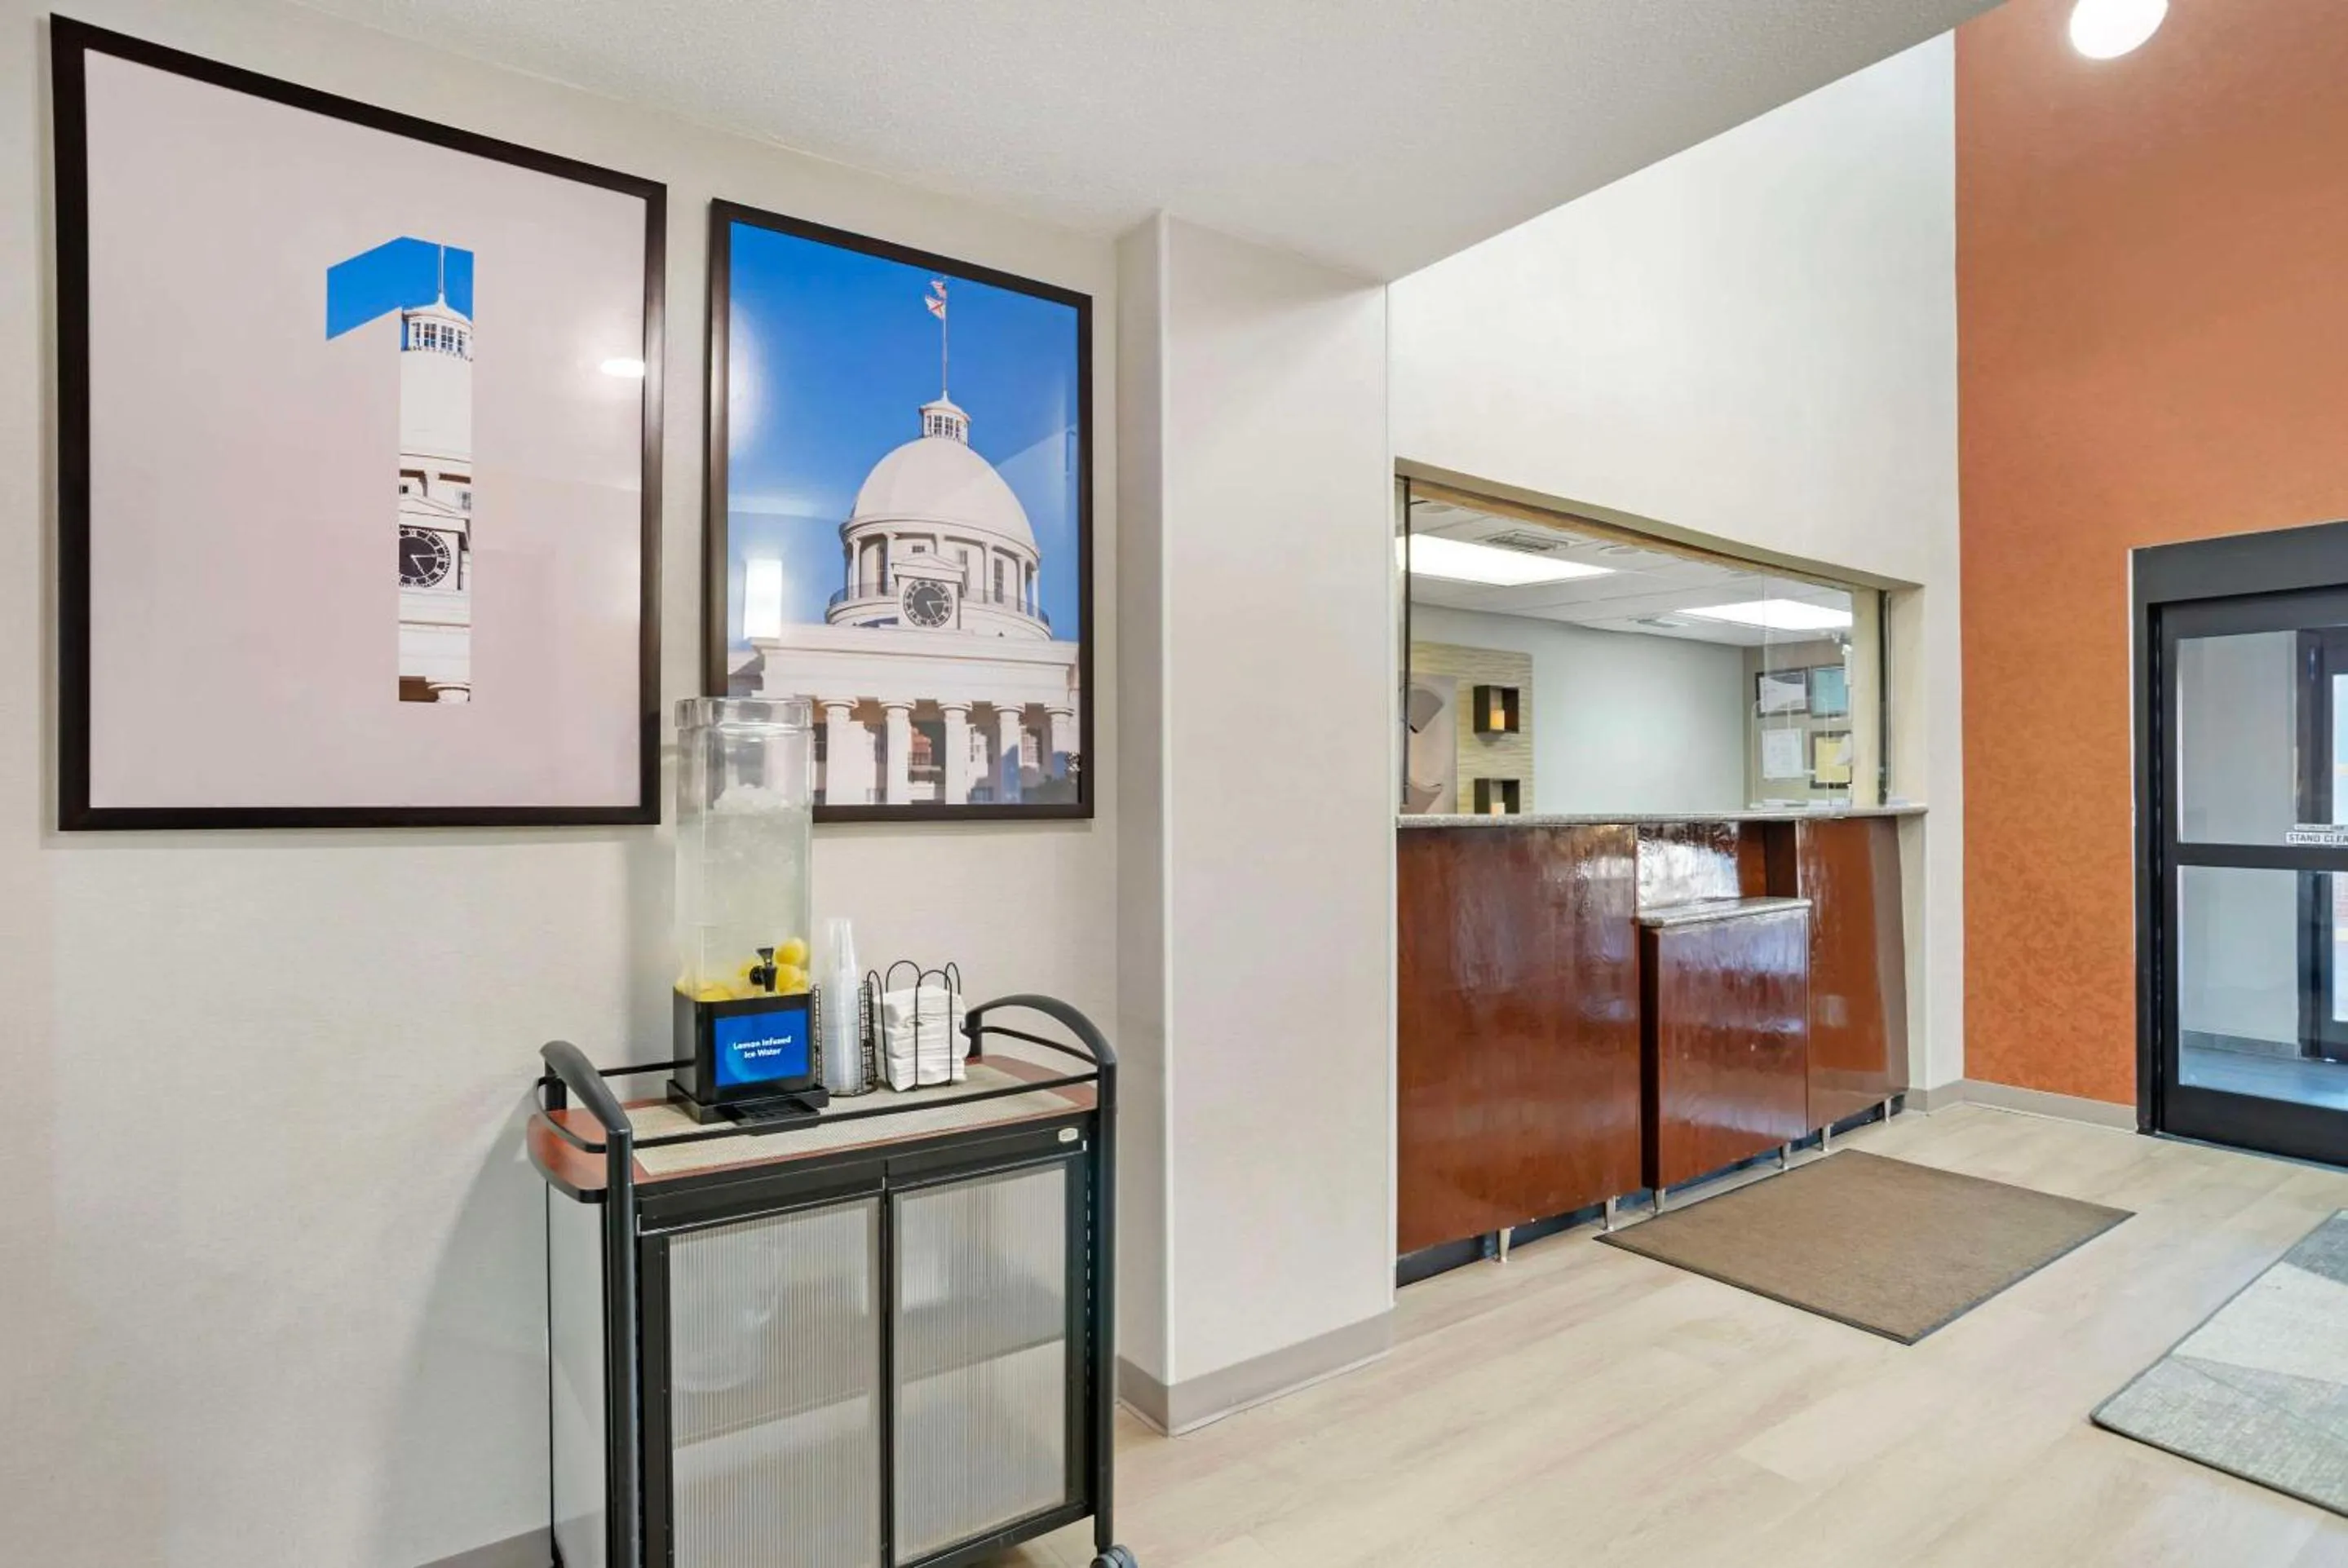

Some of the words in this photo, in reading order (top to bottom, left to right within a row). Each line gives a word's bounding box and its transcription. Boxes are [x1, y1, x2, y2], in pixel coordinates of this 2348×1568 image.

[2288, 833, 2321, 842] STAND
[733, 1041, 761, 1050] Lemon
[762, 1036, 792, 1046] Infused
[744, 1050, 756, 1058] Ice
[757, 1048, 781, 1056] Water
